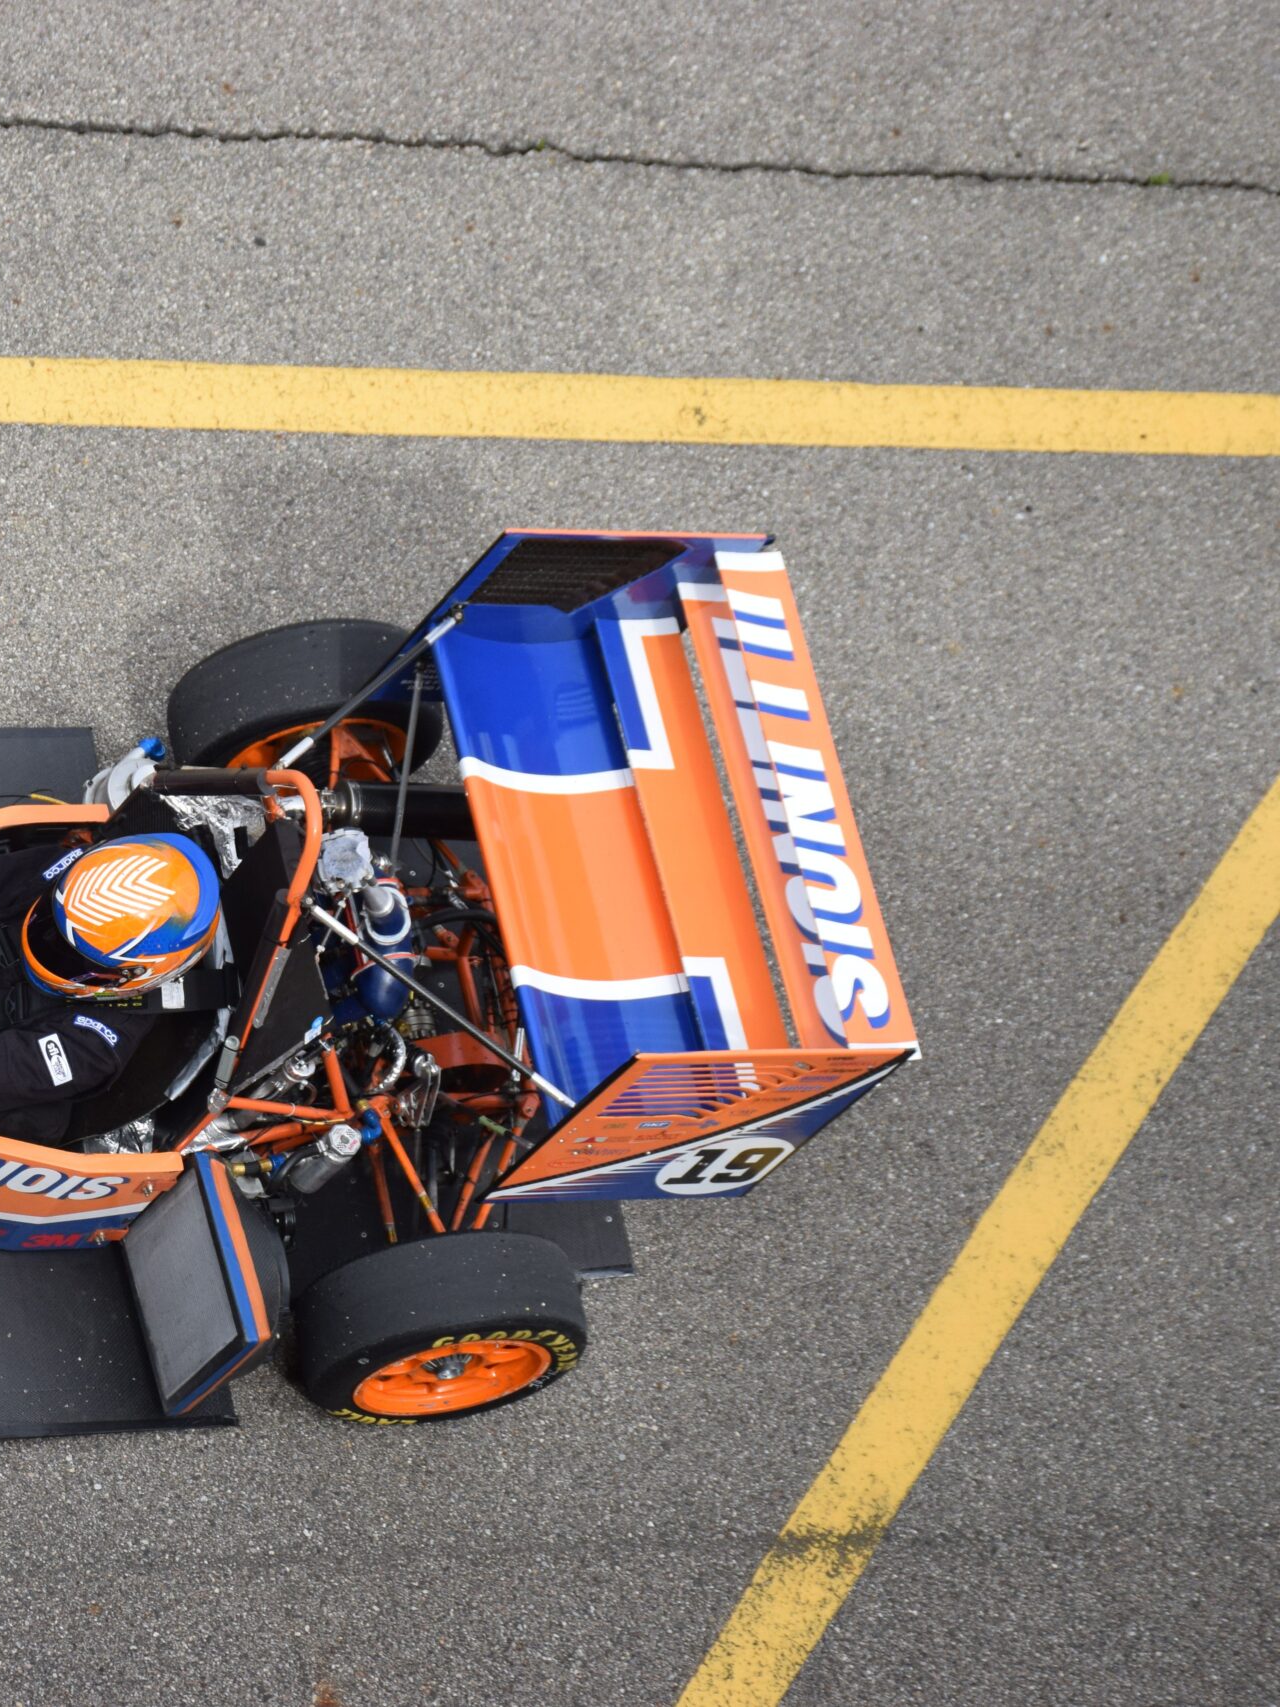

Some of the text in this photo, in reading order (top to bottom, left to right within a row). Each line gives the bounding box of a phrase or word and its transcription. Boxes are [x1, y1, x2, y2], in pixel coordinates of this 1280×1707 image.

[75, 1015, 118, 1045] sparco
[664, 1147, 786, 1185] 19
[21, 1233, 82, 1248] 3M
